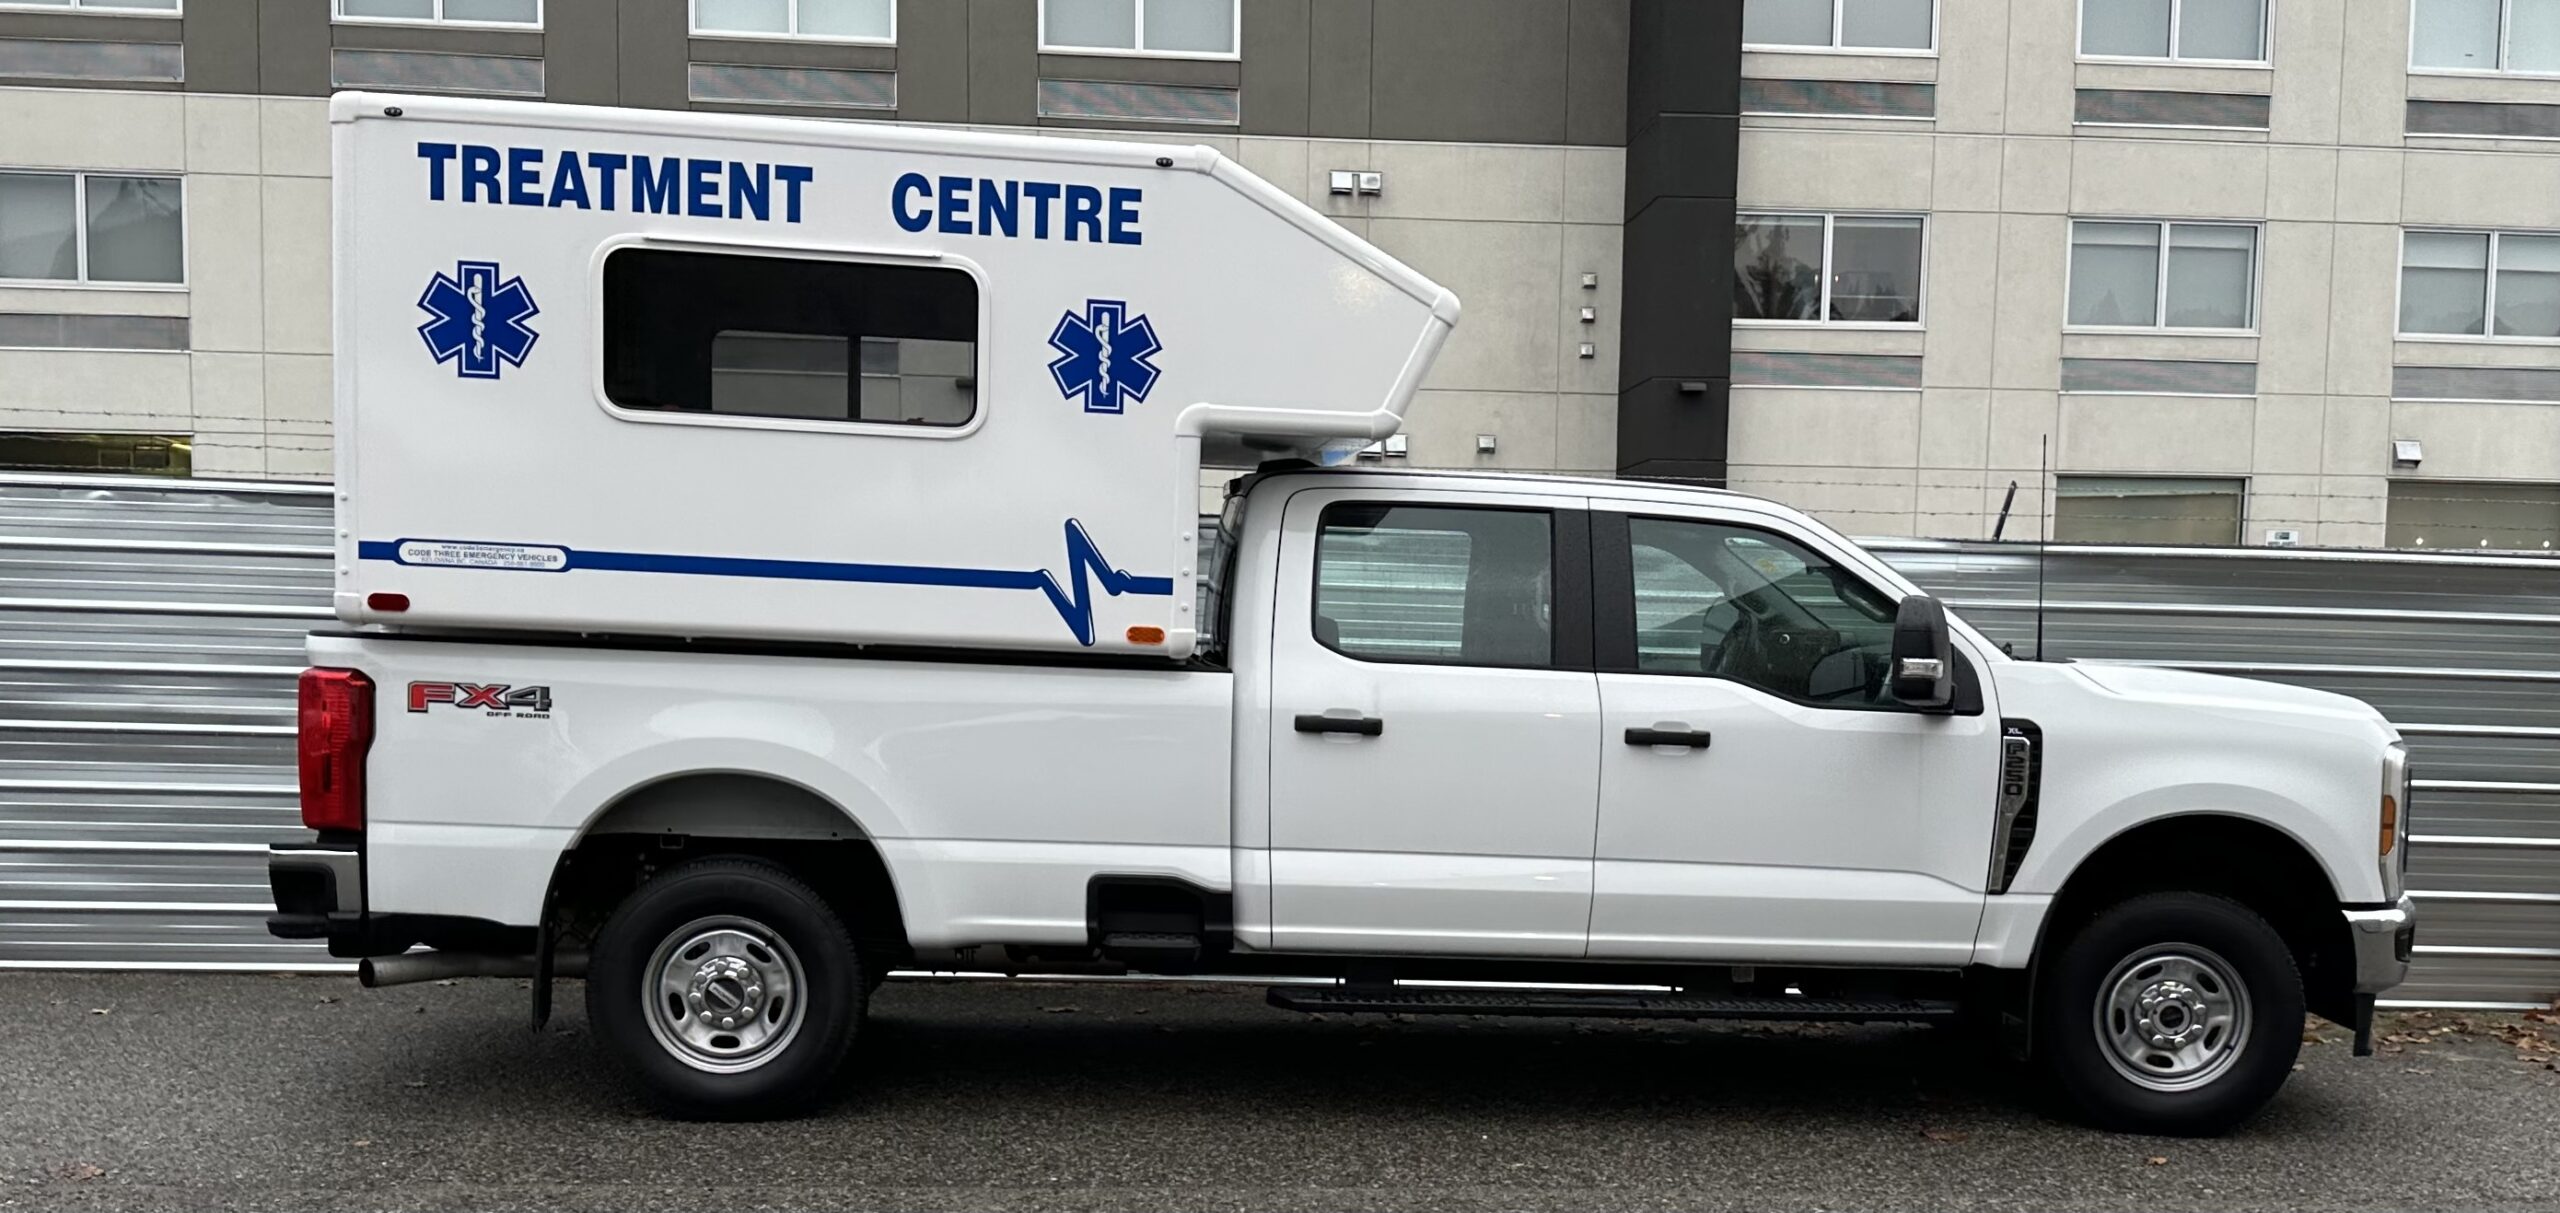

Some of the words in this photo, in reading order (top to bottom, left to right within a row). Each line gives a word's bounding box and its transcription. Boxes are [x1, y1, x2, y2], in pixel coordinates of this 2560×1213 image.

[417, 142, 813, 223] TREATMENT
[891, 172, 1142, 245] CENTRE
[407, 548, 432, 557] CODE
[433, 549, 461, 558] THREE
[463, 551, 516, 561] EMERGENCY
[517, 554, 558, 563] VEHICLES
[407, 681, 552, 713] FX4
